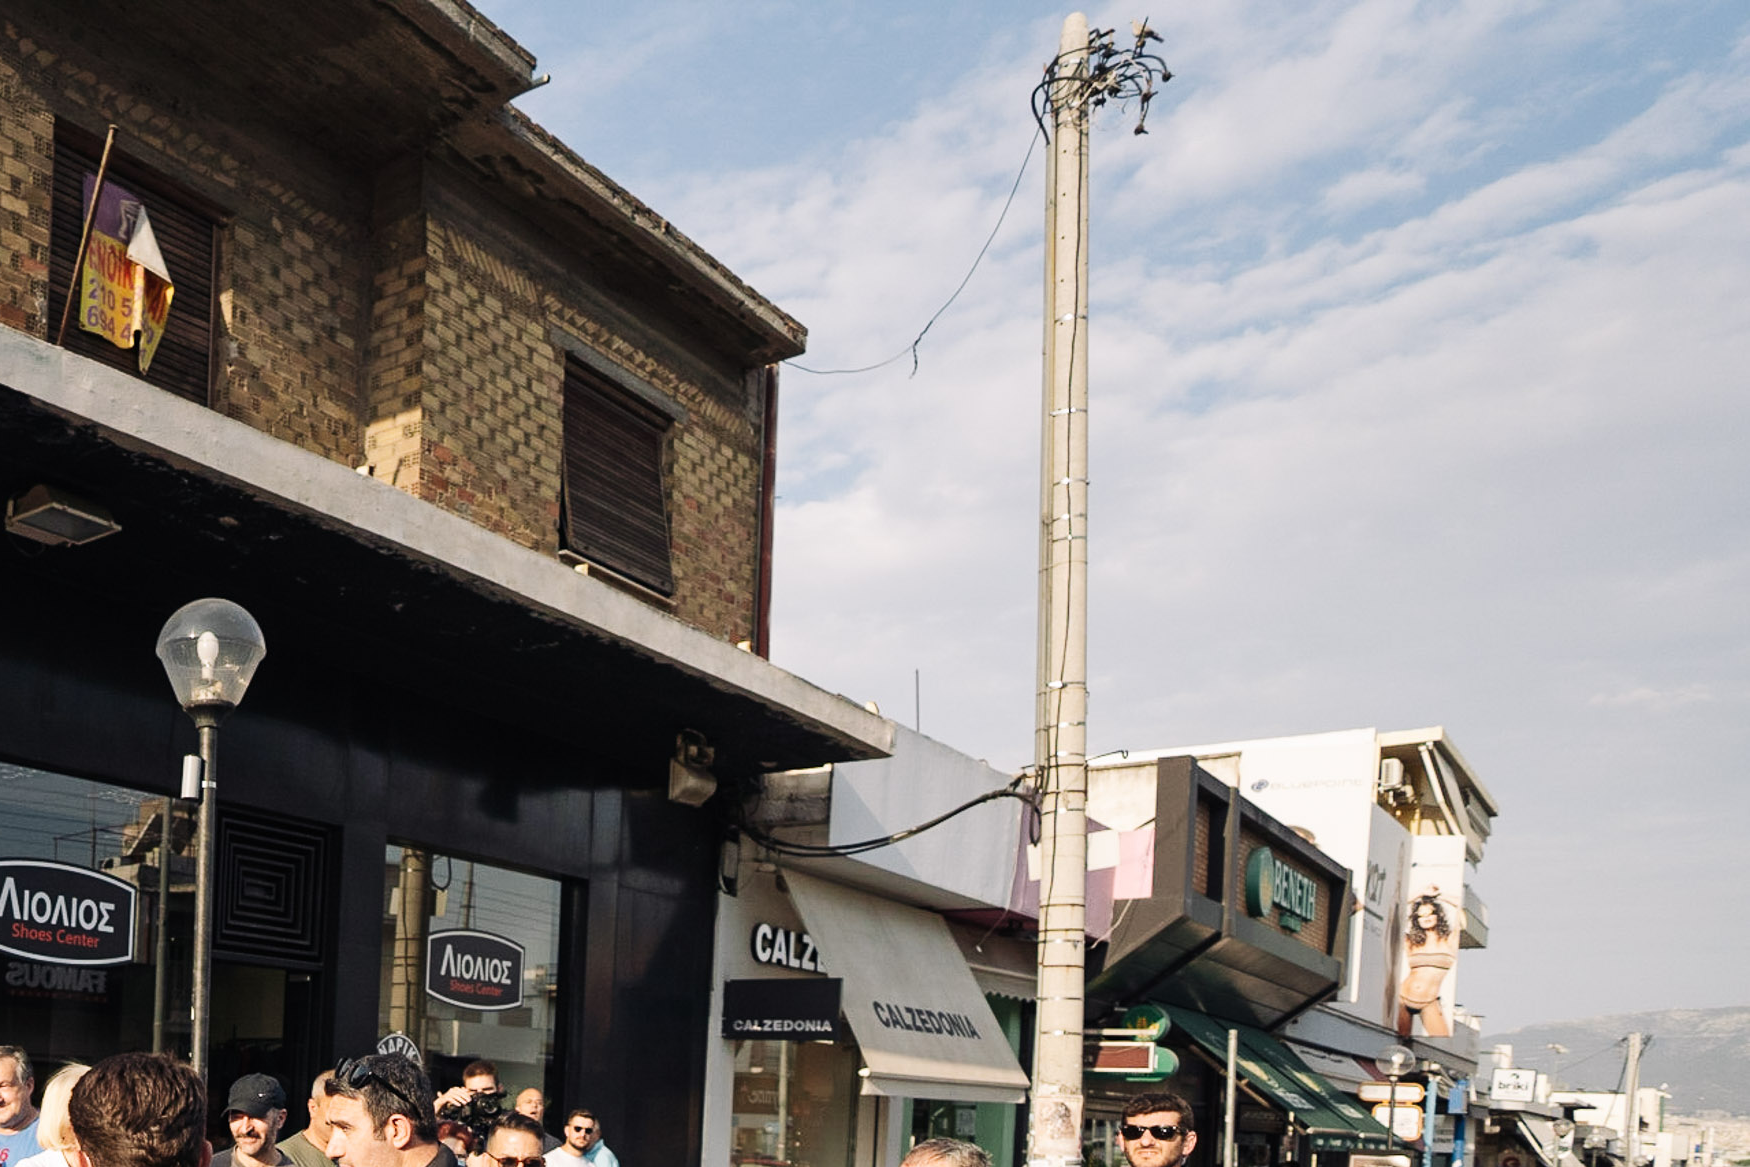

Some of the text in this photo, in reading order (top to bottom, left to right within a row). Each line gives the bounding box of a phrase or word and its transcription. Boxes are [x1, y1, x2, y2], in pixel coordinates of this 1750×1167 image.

[88, 277, 116, 312] 210
[11, 922, 100, 949] Shoes Center
[440, 944, 512, 985] ΛΙΟΛΙΟΣ
[450, 980, 504, 997] Shoes Center
[733, 1019, 833, 1032] CALZEDONIA
[873, 1001, 982, 1040] CALZEDONIA
